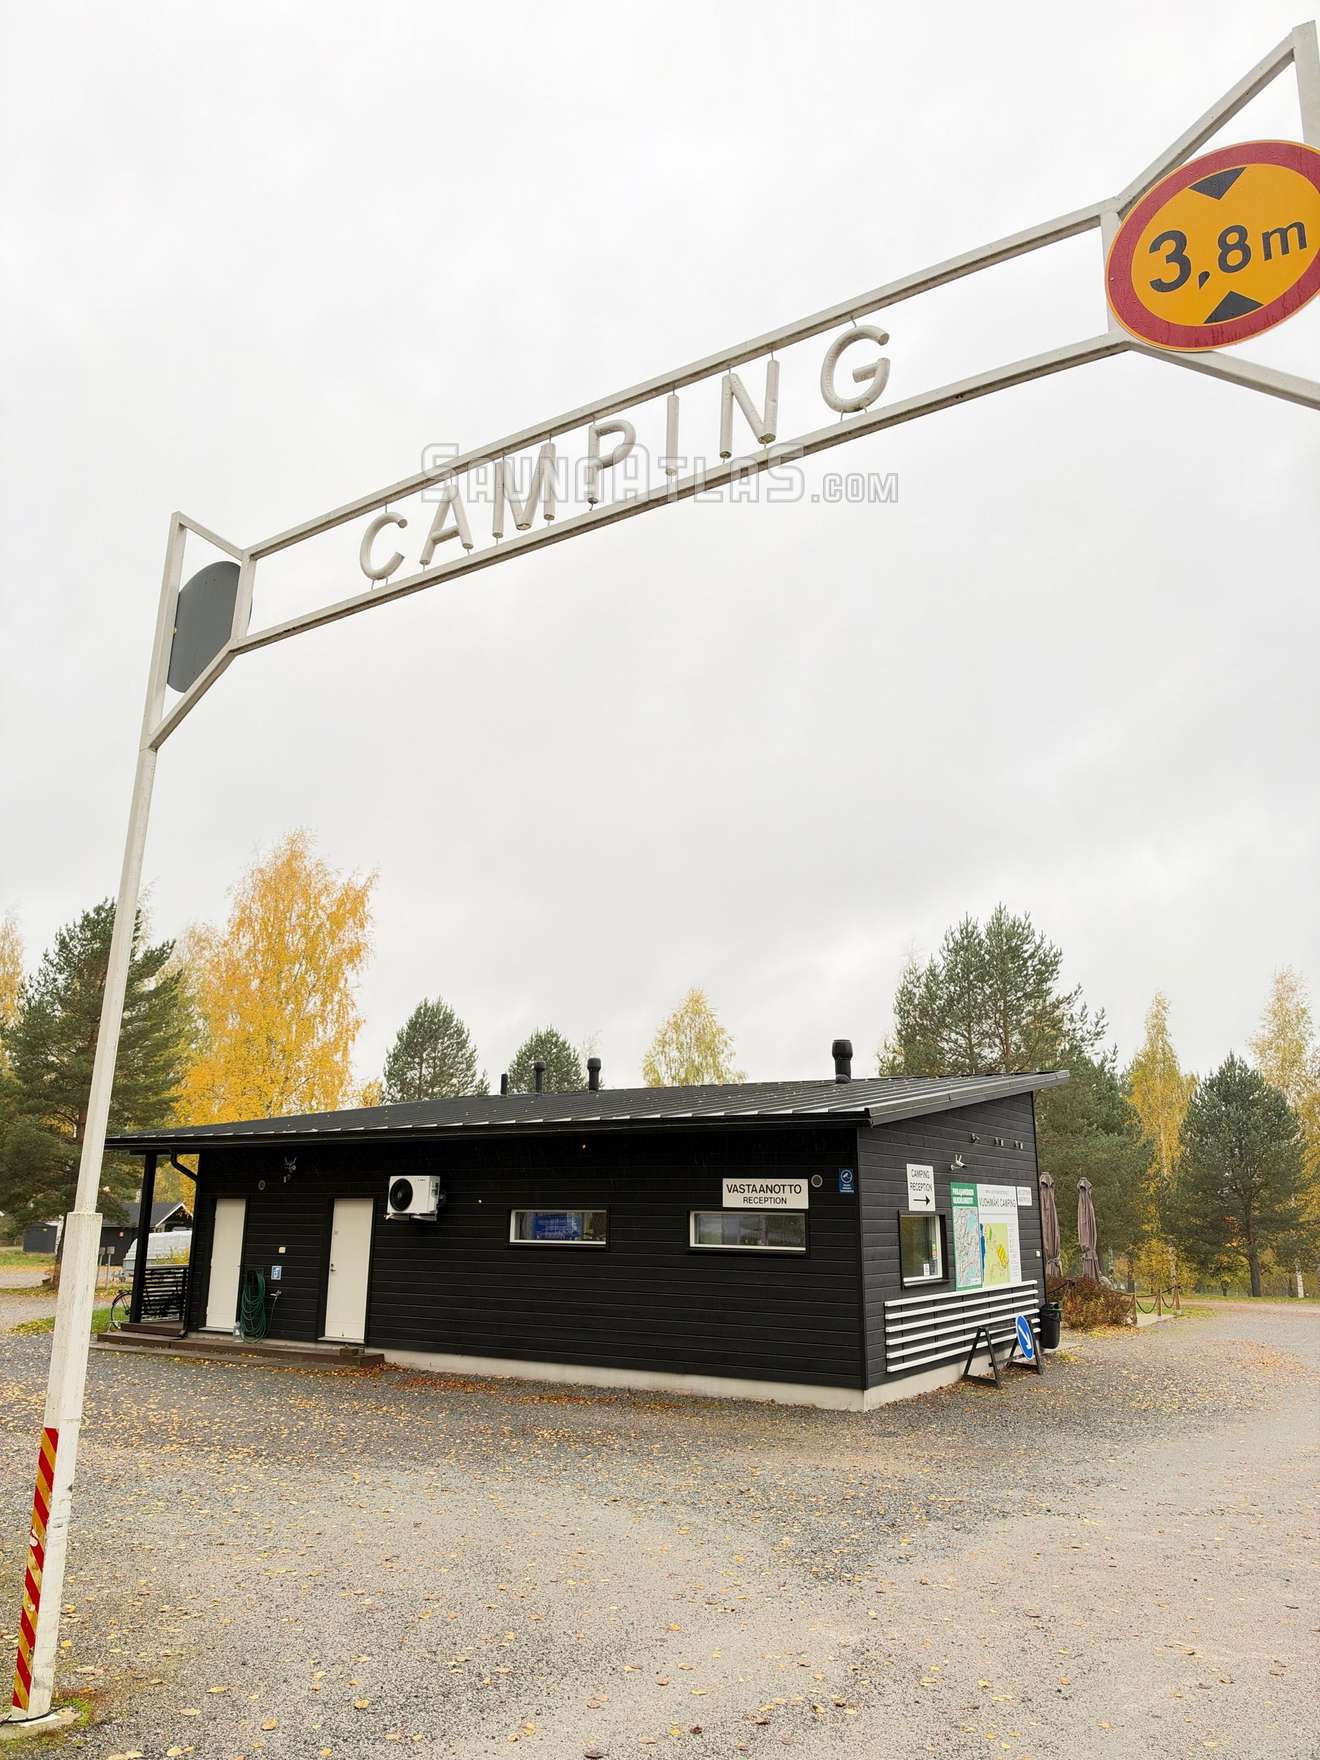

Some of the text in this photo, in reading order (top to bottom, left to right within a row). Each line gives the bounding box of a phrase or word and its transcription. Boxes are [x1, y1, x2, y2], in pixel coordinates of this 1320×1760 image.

[360, 325, 891, 579] CAMPING
[726, 1183, 802, 1194] VASTAANOTTO
[743, 1196, 787, 1205] RECEPTION
